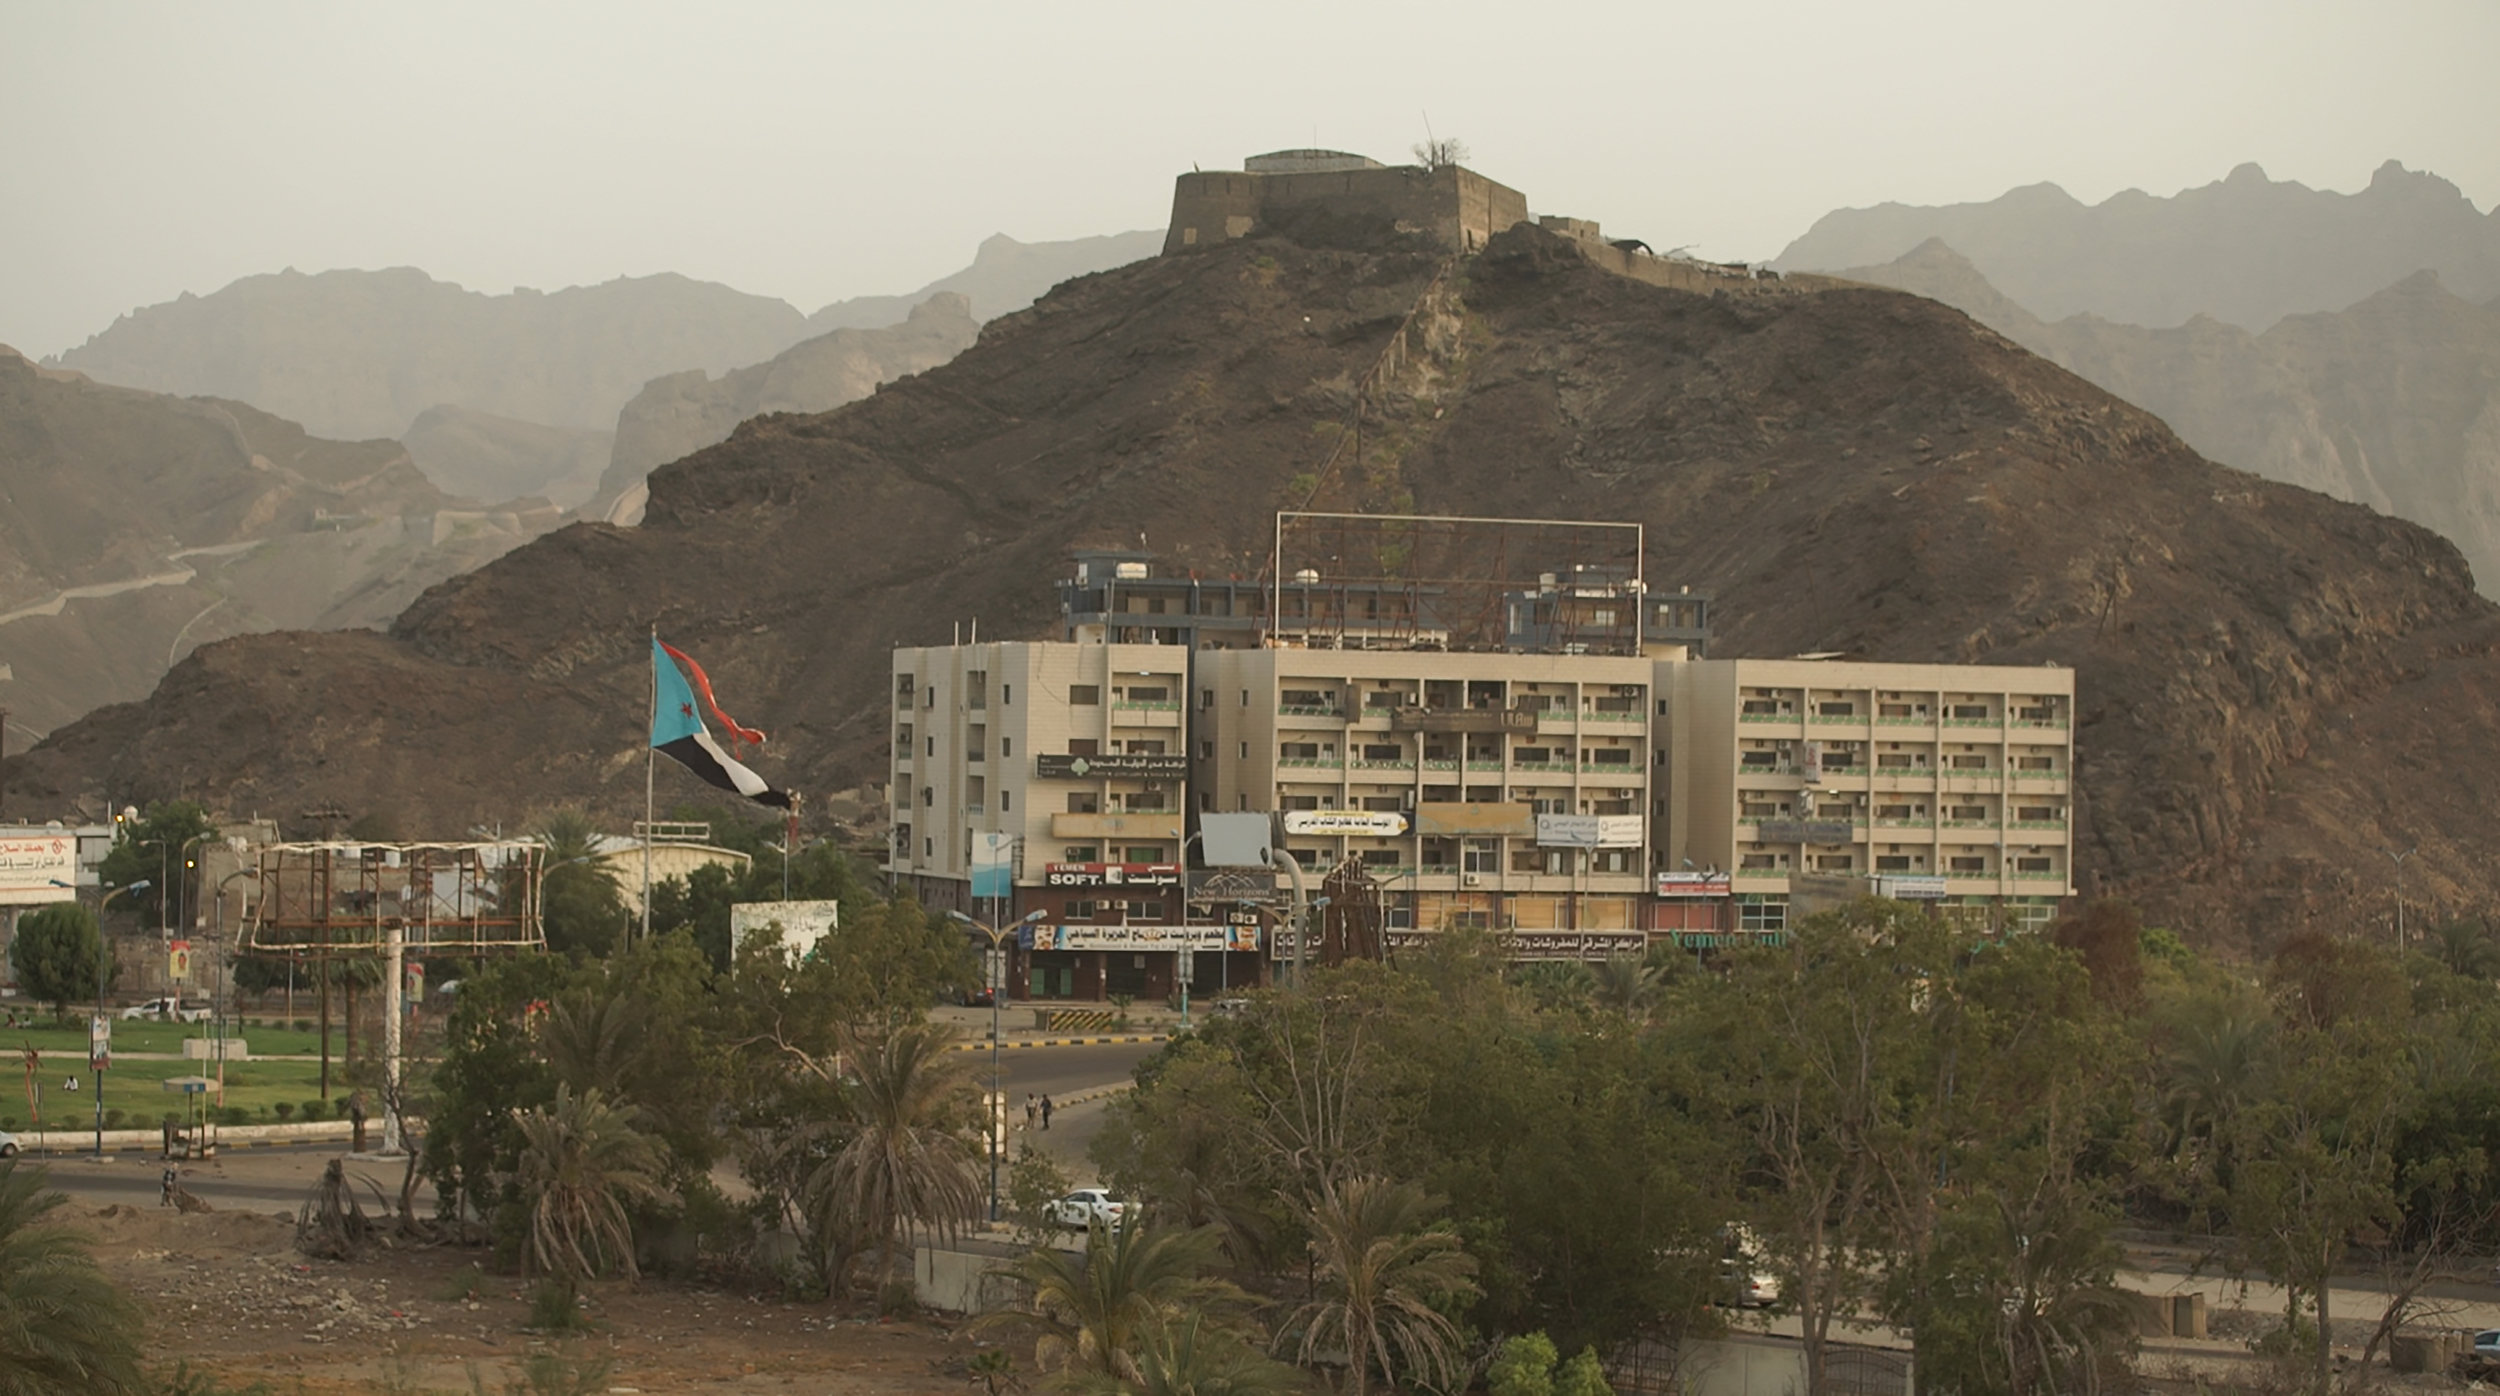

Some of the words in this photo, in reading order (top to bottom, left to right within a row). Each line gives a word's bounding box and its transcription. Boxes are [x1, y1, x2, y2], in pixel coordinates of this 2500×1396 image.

[1052, 864, 1086, 872] YEMEN
[1193, 886, 1216, 896] New
[1223, 886, 1270, 896] Horizons
